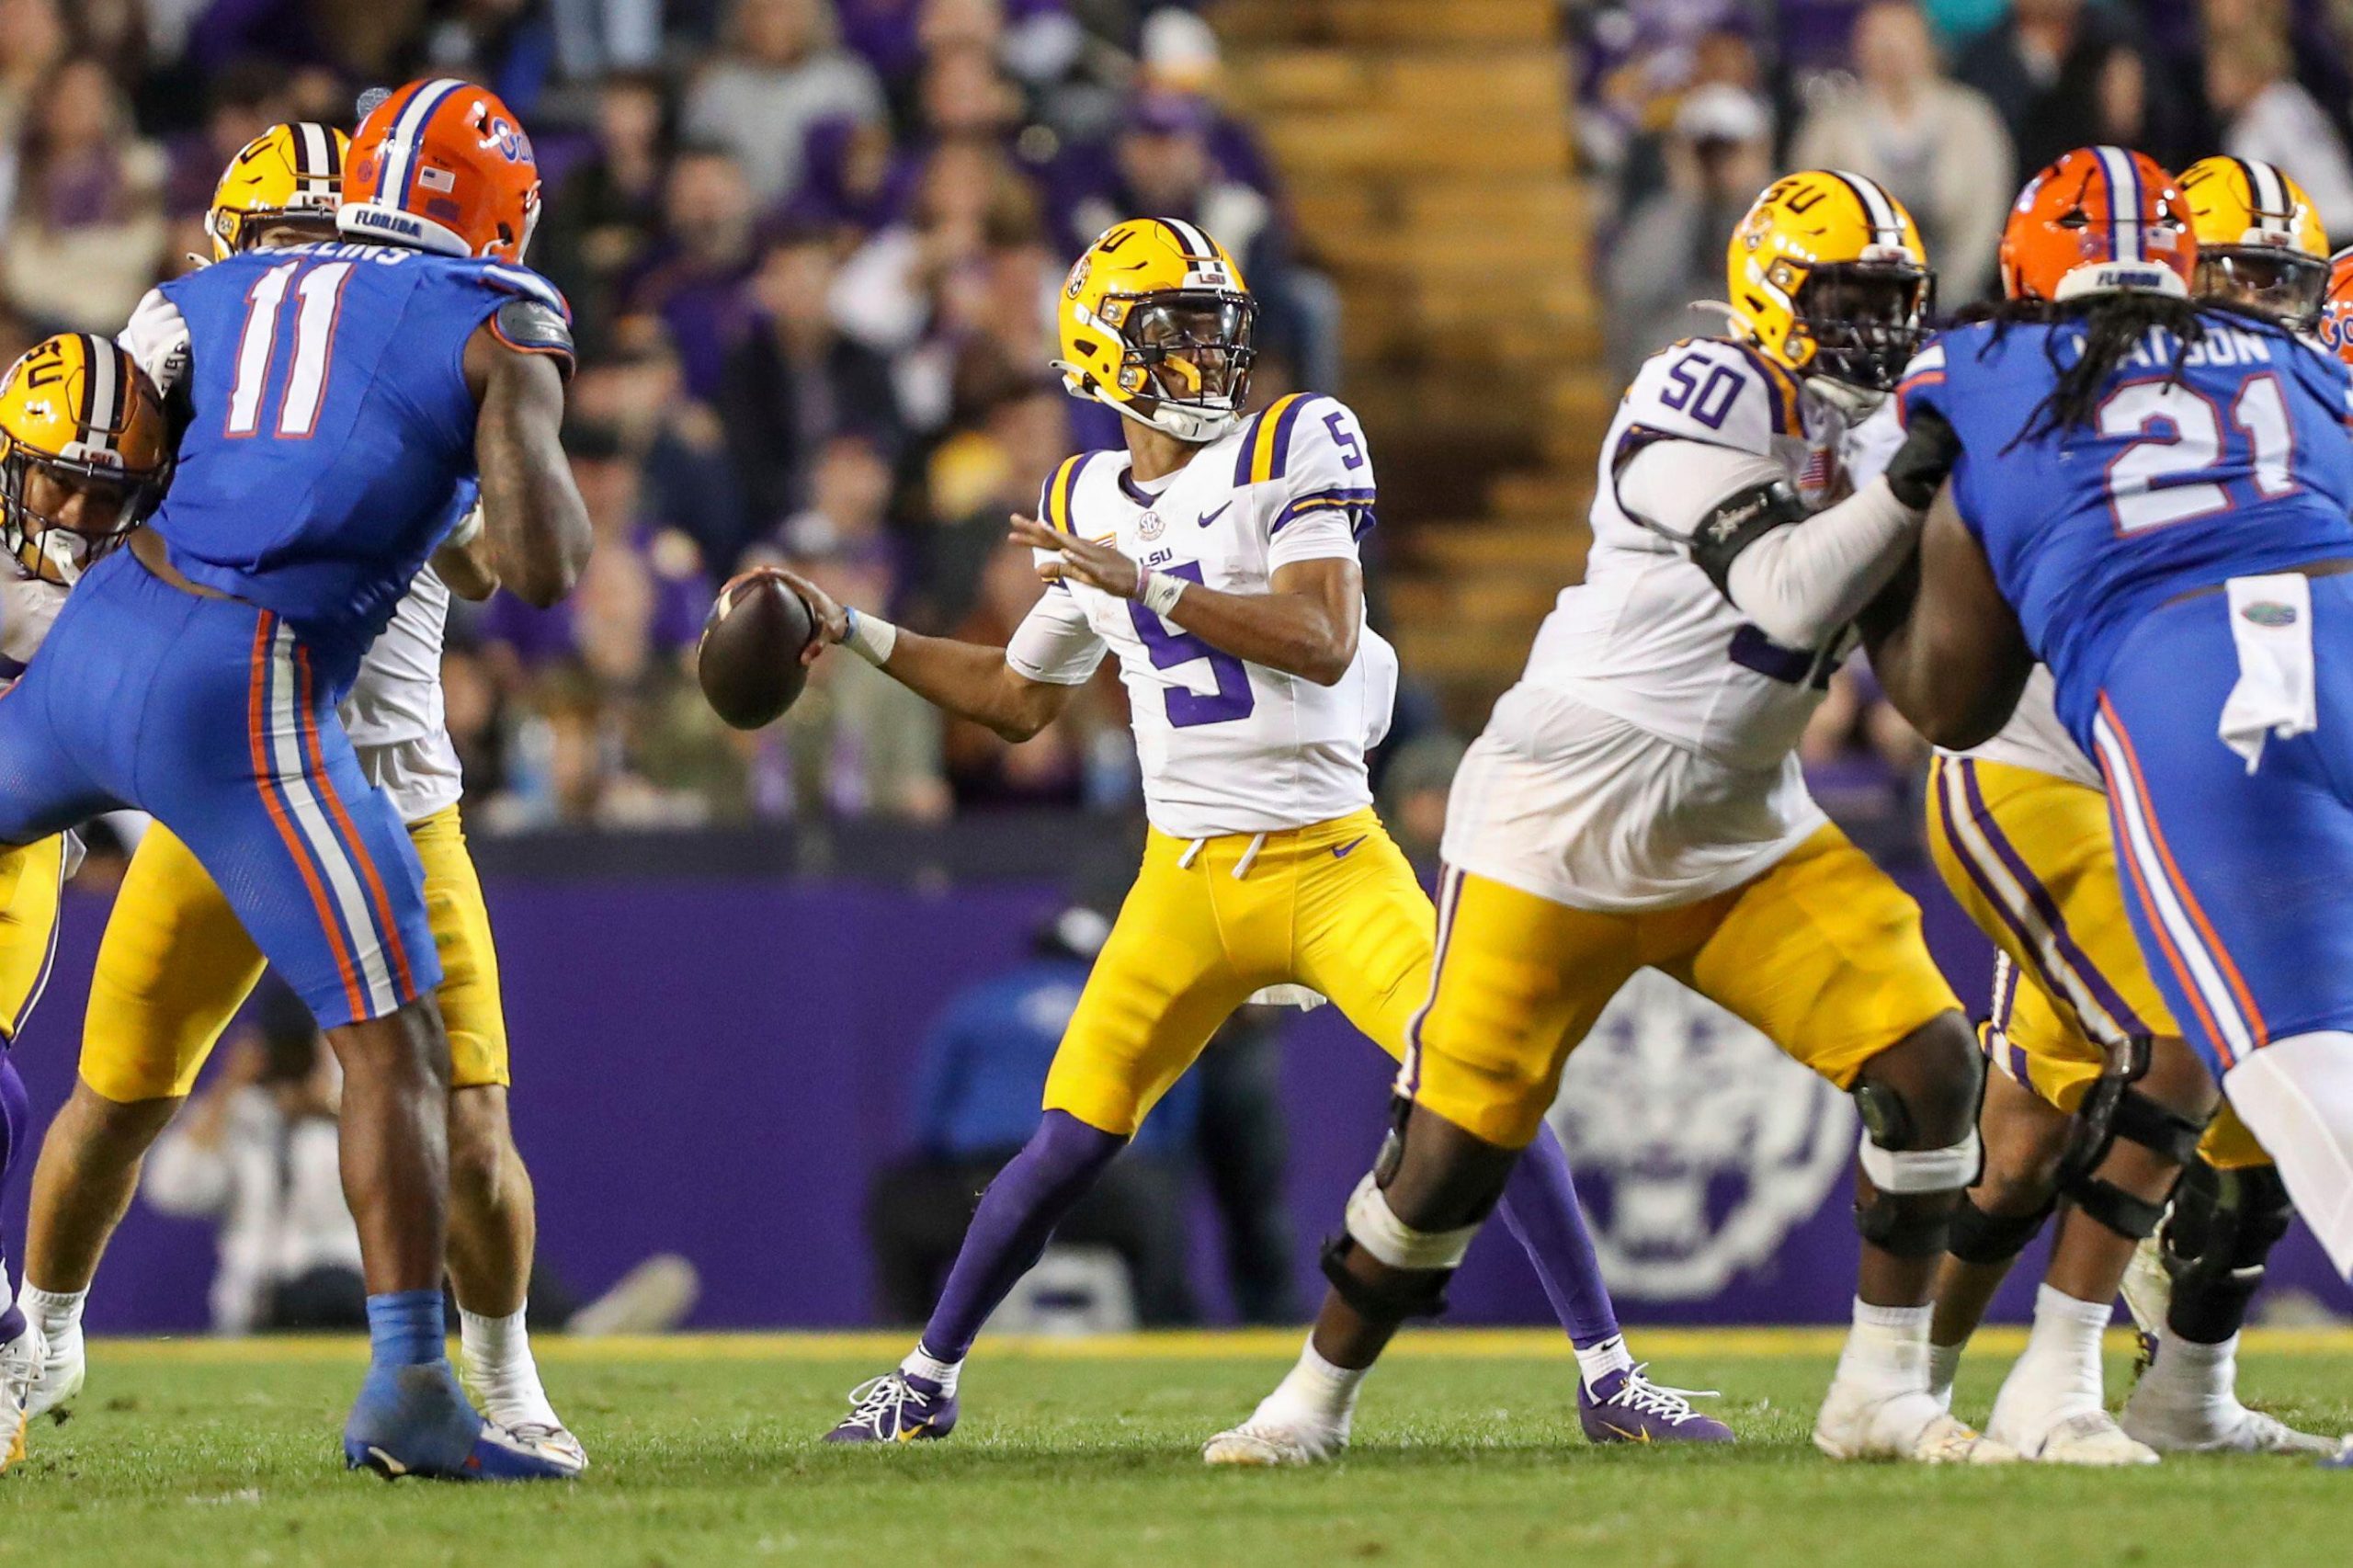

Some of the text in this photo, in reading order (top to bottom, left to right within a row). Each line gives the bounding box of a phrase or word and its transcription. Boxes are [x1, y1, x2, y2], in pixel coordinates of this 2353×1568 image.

[1763, 180, 1827, 214] SU
[223, 256, 358, 439] 11
[1660, 352, 1746, 431] 50
[1322, 411, 1364, 472] 5
[2095, 370, 2303, 540] 21
[1140, 547, 1173, 567] LSU
